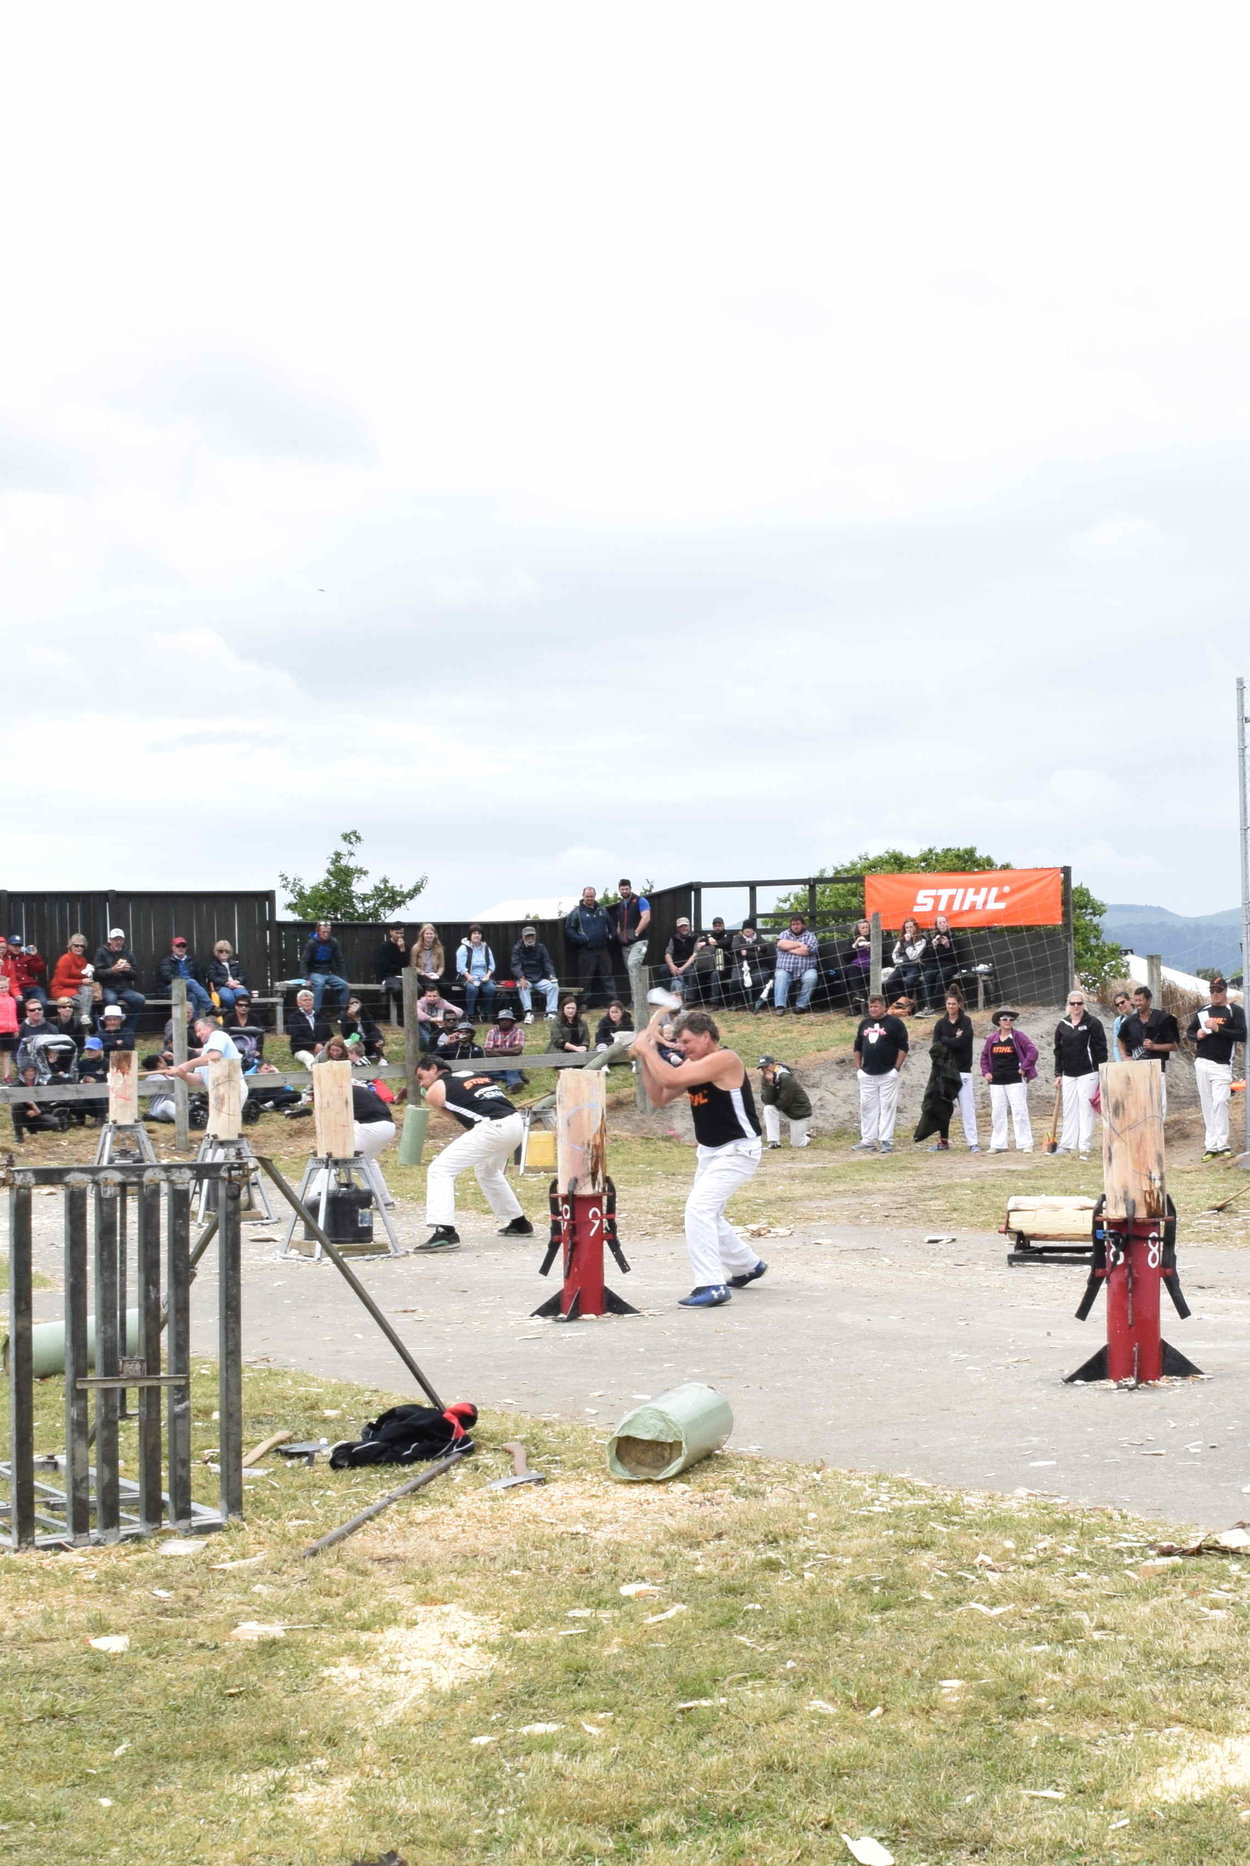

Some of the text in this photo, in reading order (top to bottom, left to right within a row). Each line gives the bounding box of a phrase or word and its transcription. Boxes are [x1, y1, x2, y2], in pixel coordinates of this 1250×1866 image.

[912, 887, 1006, 912] STIHL
[588, 1207, 601, 1238] 9
[1147, 1231, 1160, 1269] 8
